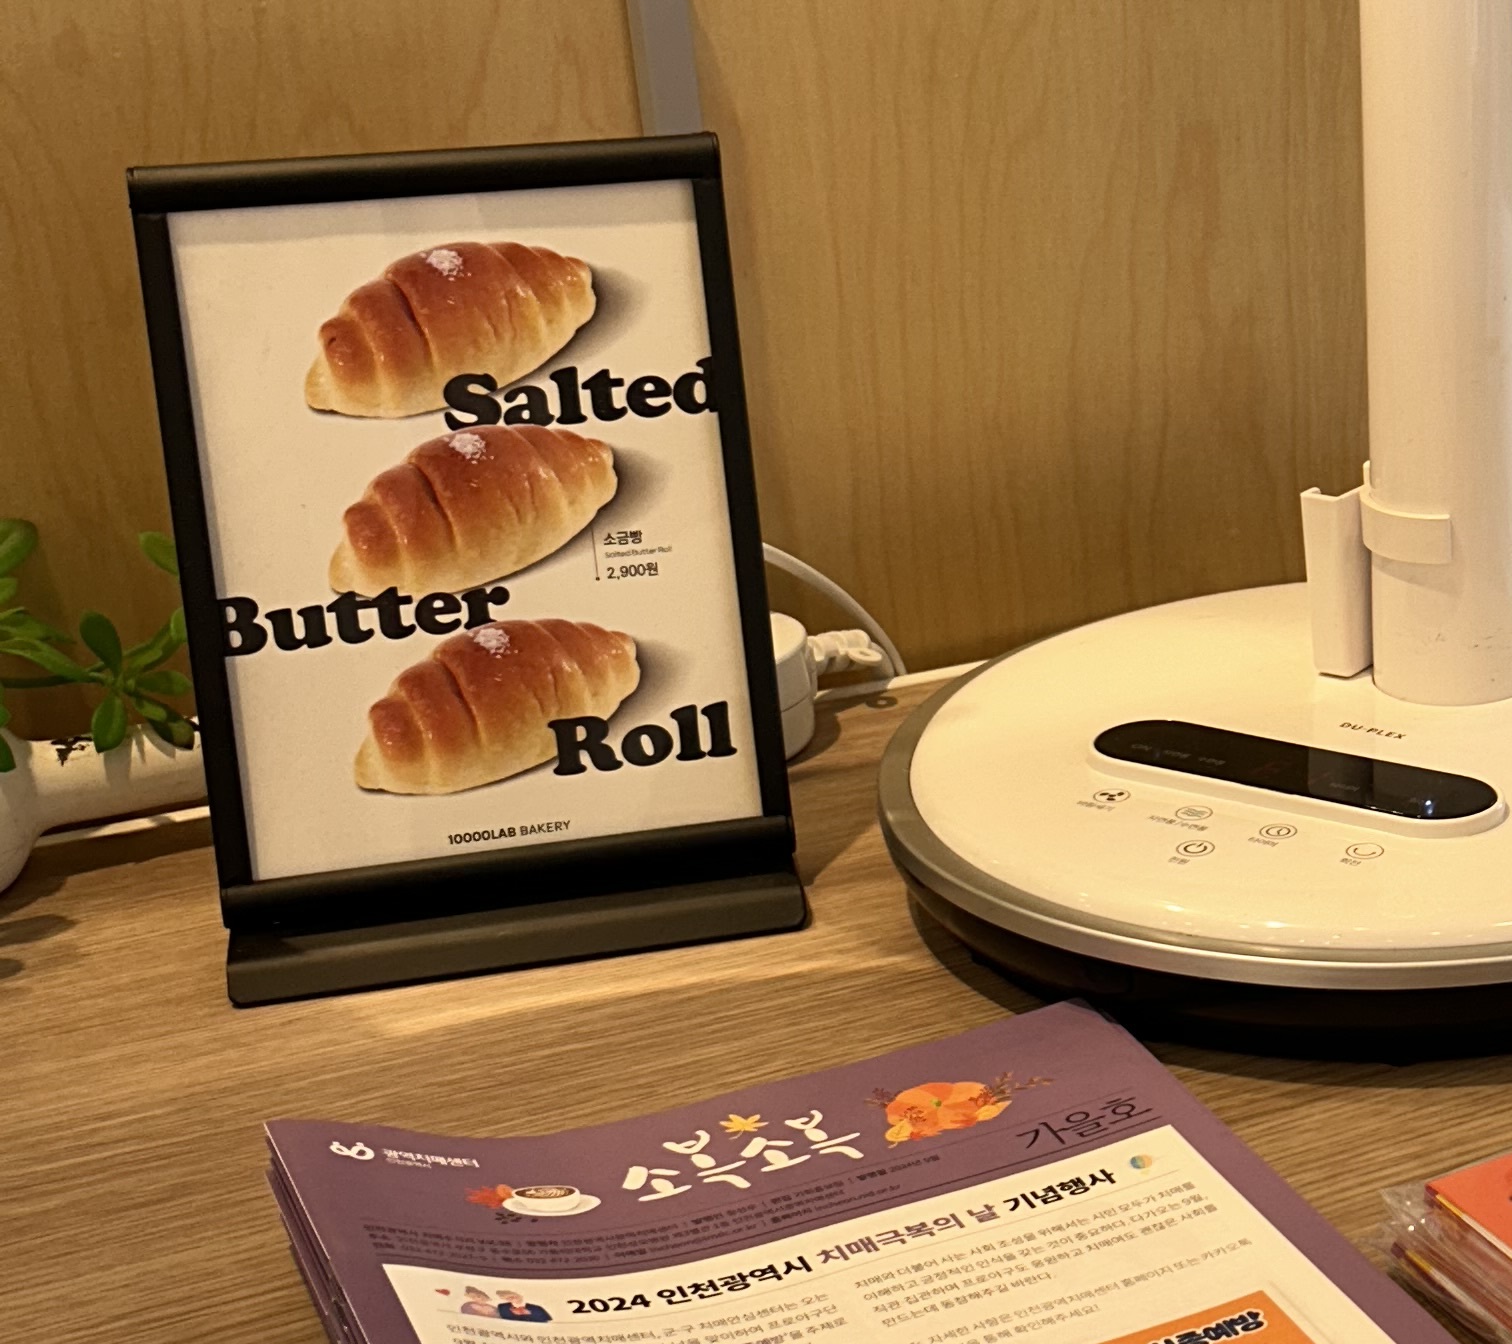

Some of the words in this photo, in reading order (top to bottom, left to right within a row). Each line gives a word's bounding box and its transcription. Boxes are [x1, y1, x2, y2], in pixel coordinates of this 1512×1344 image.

[443, 357, 720, 432] Salted
[604, 530, 642, 545] 소금빵
[607, 562, 658, 580] 2,900원
[221, 584, 510, 658] Butter
[549, 702, 738, 778] Roll
[1339, 722, 1406, 741] DU-PLEX
[448, 827, 516, 845] 10000LAB
[520, 820, 570, 836] BAKERY
[1015, 1094, 1153, 1150] 가을호
[382, 1147, 480, 1168] 광역치매센터
[622, 1110, 864, 1203] 소복소복
[568, 1285, 653, 1318] 2024
[656, 1256, 813, 1305] 인천광역시
[816, 1211, 964, 1265] 치매극복의
[968, 1202, 1000, 1226] 날
[1003, 1168, 1117, 1214] 기념행사
